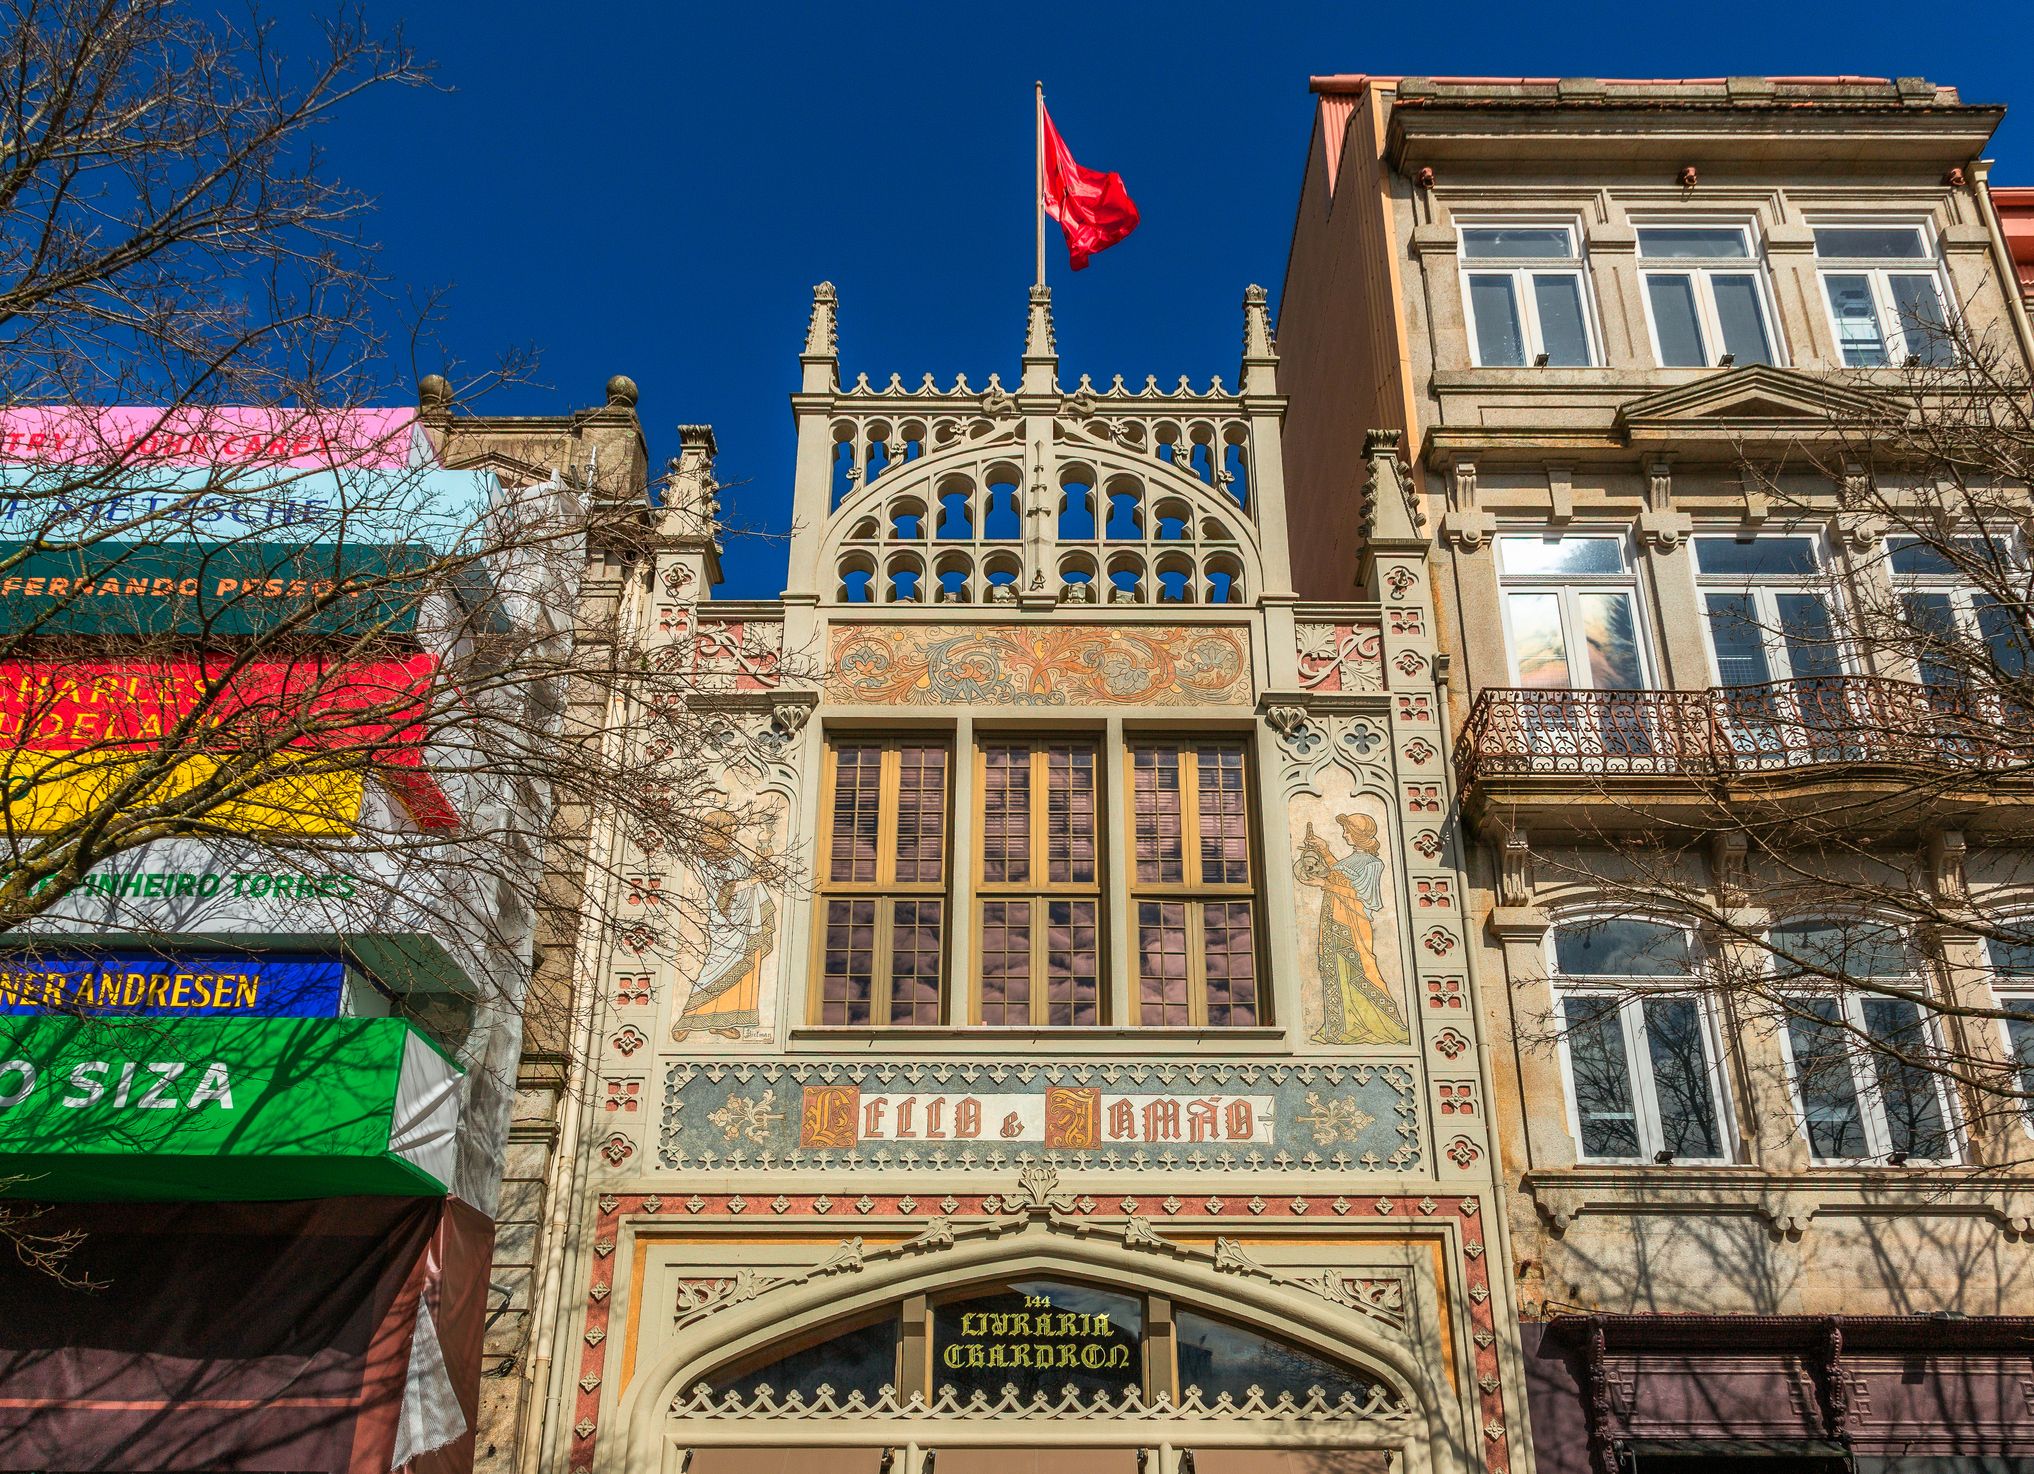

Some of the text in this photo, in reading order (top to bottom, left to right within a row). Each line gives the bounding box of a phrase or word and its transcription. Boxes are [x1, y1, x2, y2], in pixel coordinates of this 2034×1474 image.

[1, 577, 200, 597] FERNANDO
[64, 873, 220, 897] INHEIRO
[231, 874, 356, 899] TORRES
[74, 973, 260, 1007] ANDRESEN
[62, 1061, 234, 1109] SIZA
[804, 1089, 982, 1148] LELLO
[1000, 1110, 1025, 1138] &
[1024, 1295, 1051, 1308] 144
[961, 1312, 1114, 1337] LIVRARIA
[943, 1343, 1130, 1369] CHARDRON
